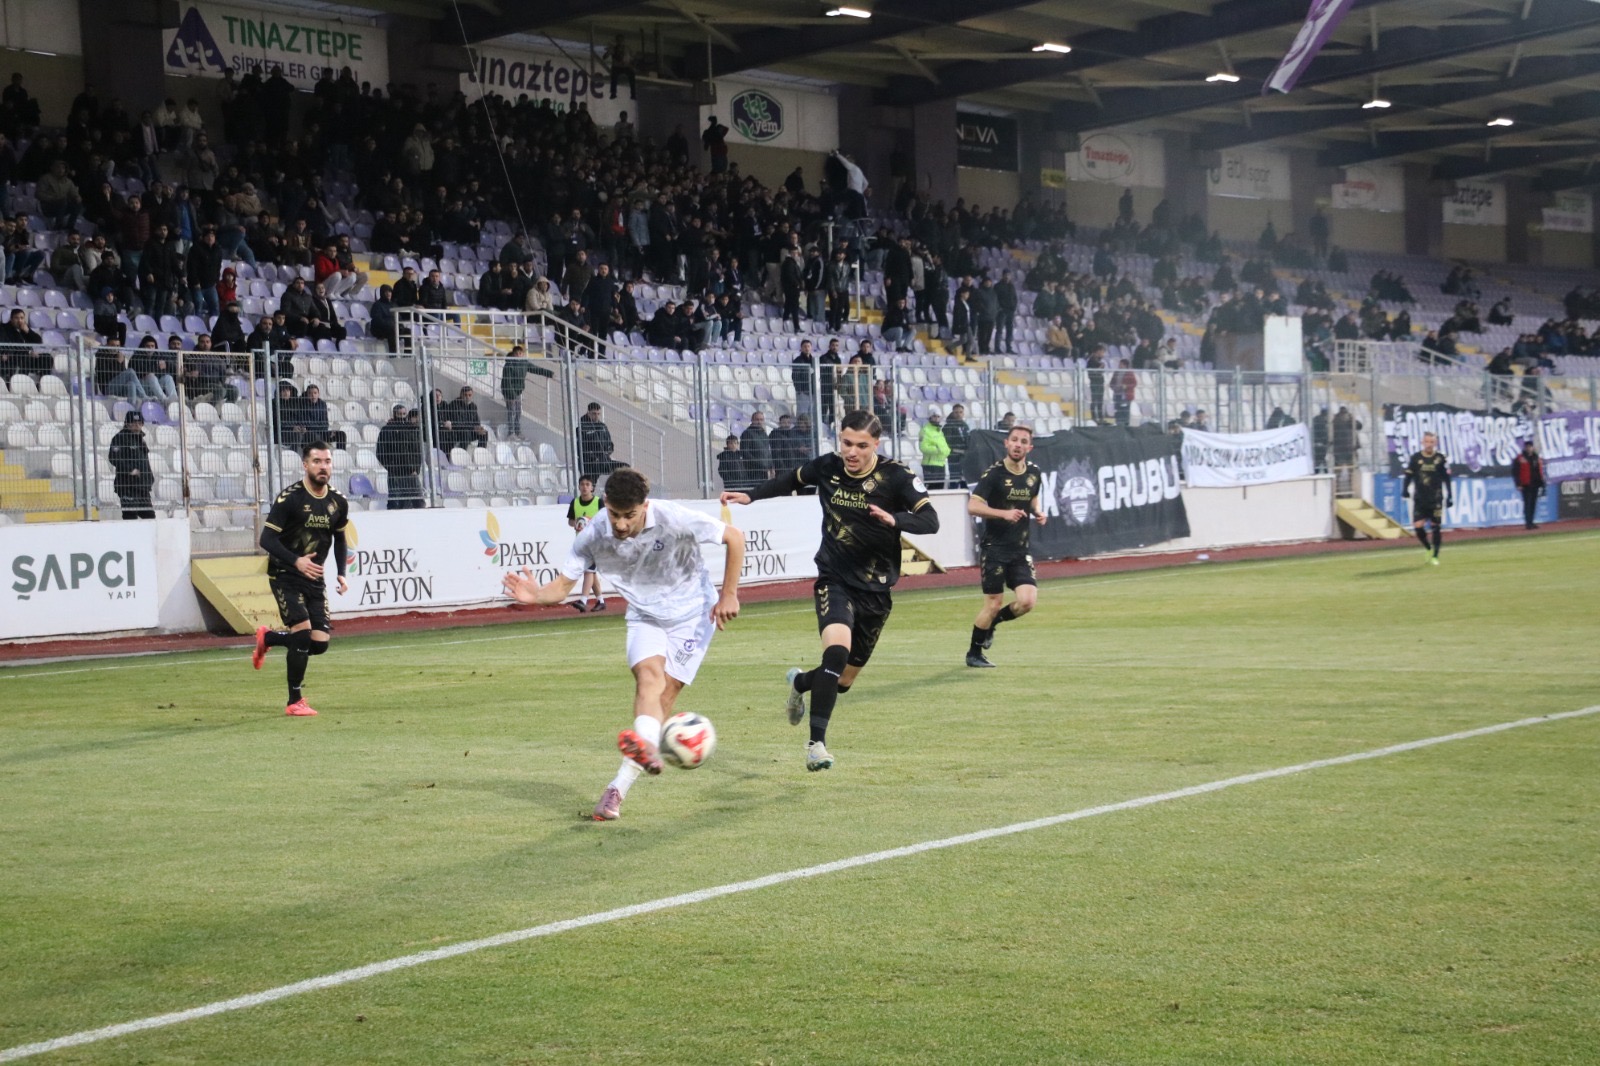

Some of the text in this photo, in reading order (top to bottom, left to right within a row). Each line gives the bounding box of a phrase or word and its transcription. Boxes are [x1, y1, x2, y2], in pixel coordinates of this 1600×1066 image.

[222, 15, 363, 61] TINAZTEPE
[754, 120, 779, 135] yem
[834, 487, 867, 502] Avek
[1098, 455, 1181, 512] GRUBU
[831, 496, 870, 510] Otomotiv
[307, 513, 330, 524] Avek
[743, 529, 773, 552] RK
[357, 547, 414, 577] PARK
[499, 541, 550, 567] PARK
[740, 553, 787, 578] FYON
[12, 550, 136, 601] ŞAPCI
[108, 591, 136, 600] YAPI
[359, 575, 434, 606] AFYON
